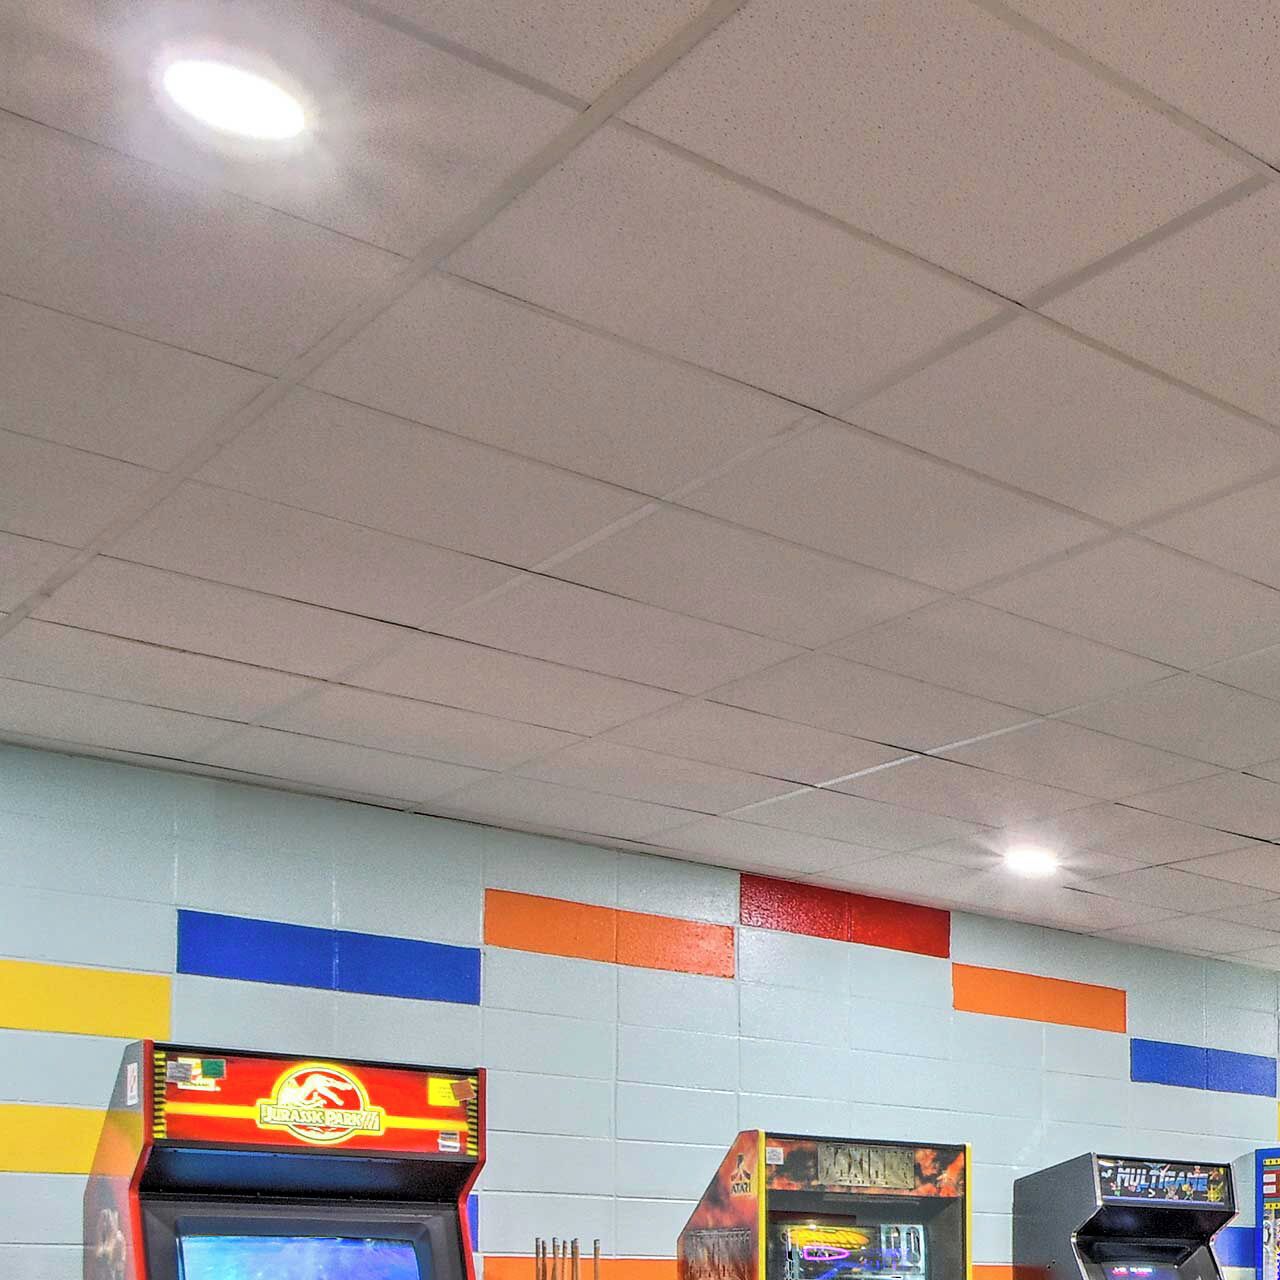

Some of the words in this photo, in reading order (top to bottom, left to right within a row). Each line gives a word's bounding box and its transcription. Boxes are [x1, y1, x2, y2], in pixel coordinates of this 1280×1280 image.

[262, 1104, 323, 1125] JURASSIC
[324, 1109, 362, 1128] PARK
[731, 1181, 752, 1194] ATARI
[1116, 1167, 1209, 1192] MULTIGAME
